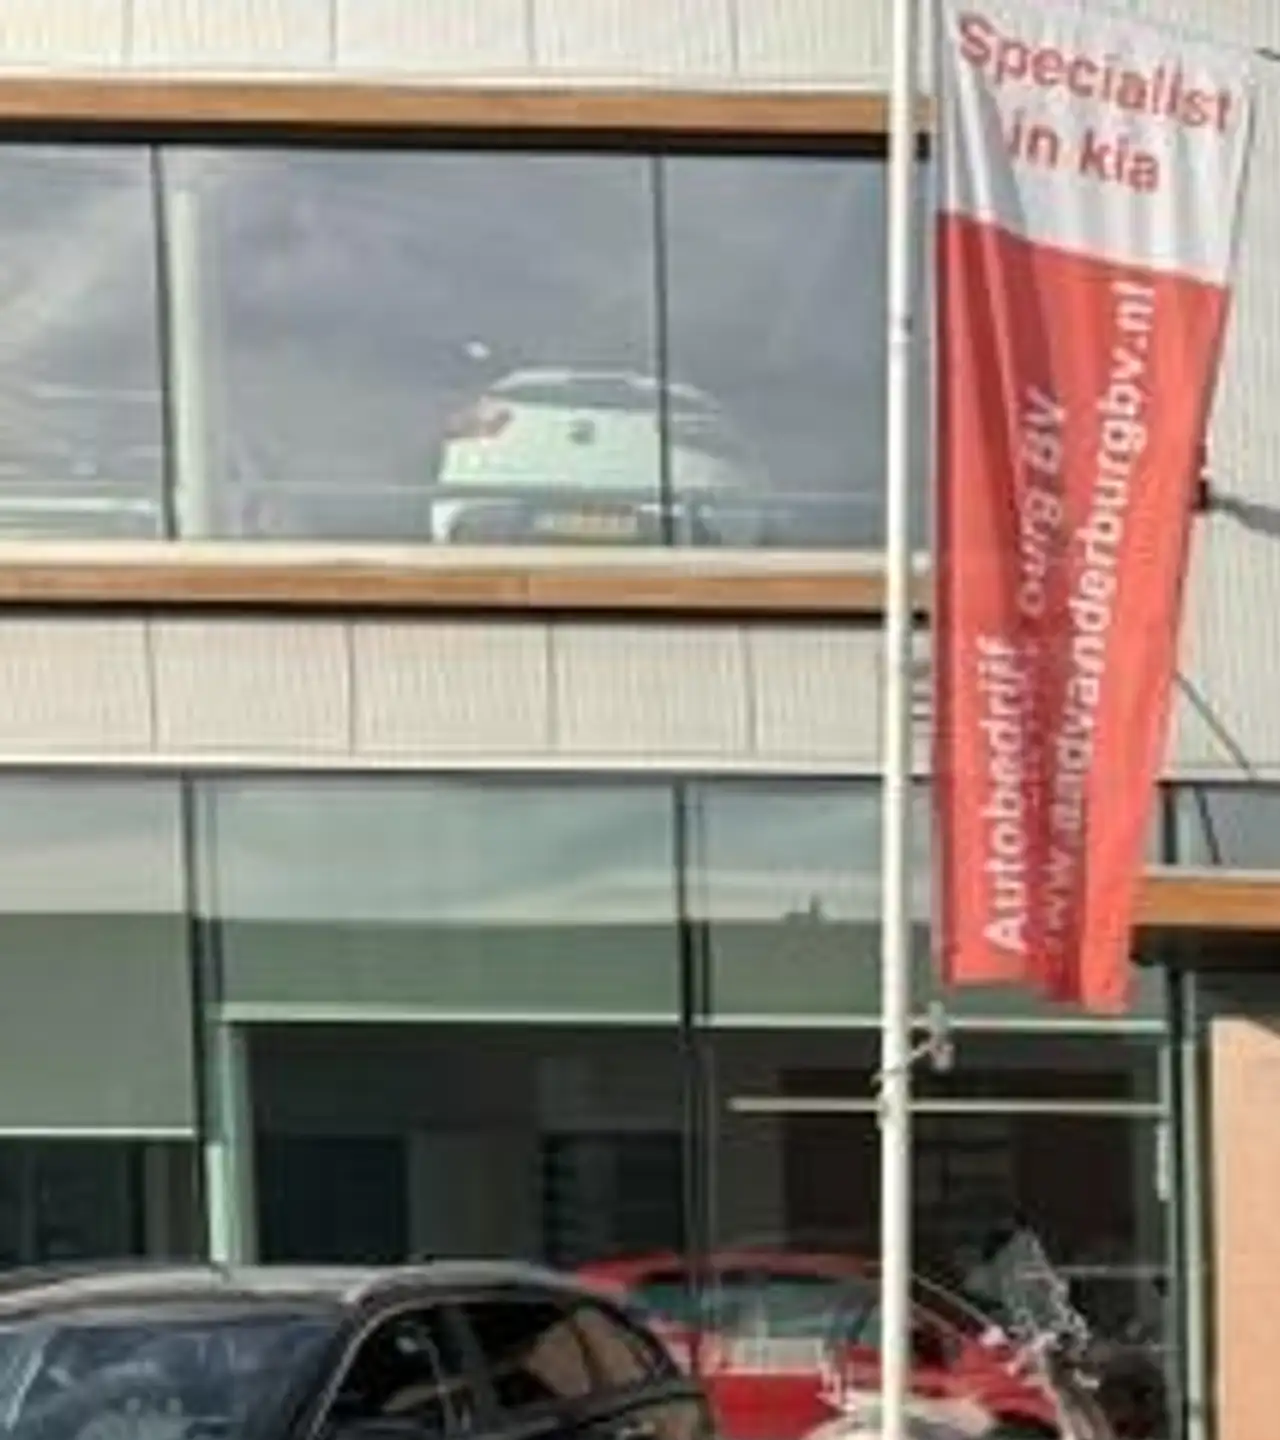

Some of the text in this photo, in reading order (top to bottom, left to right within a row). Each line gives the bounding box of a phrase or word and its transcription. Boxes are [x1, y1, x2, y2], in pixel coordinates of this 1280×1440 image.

[958, 13, 1233, 133] Specialist
[1008, 110, 1059, 165] in
[976, 634, 1028, 953] Autobedrijf
